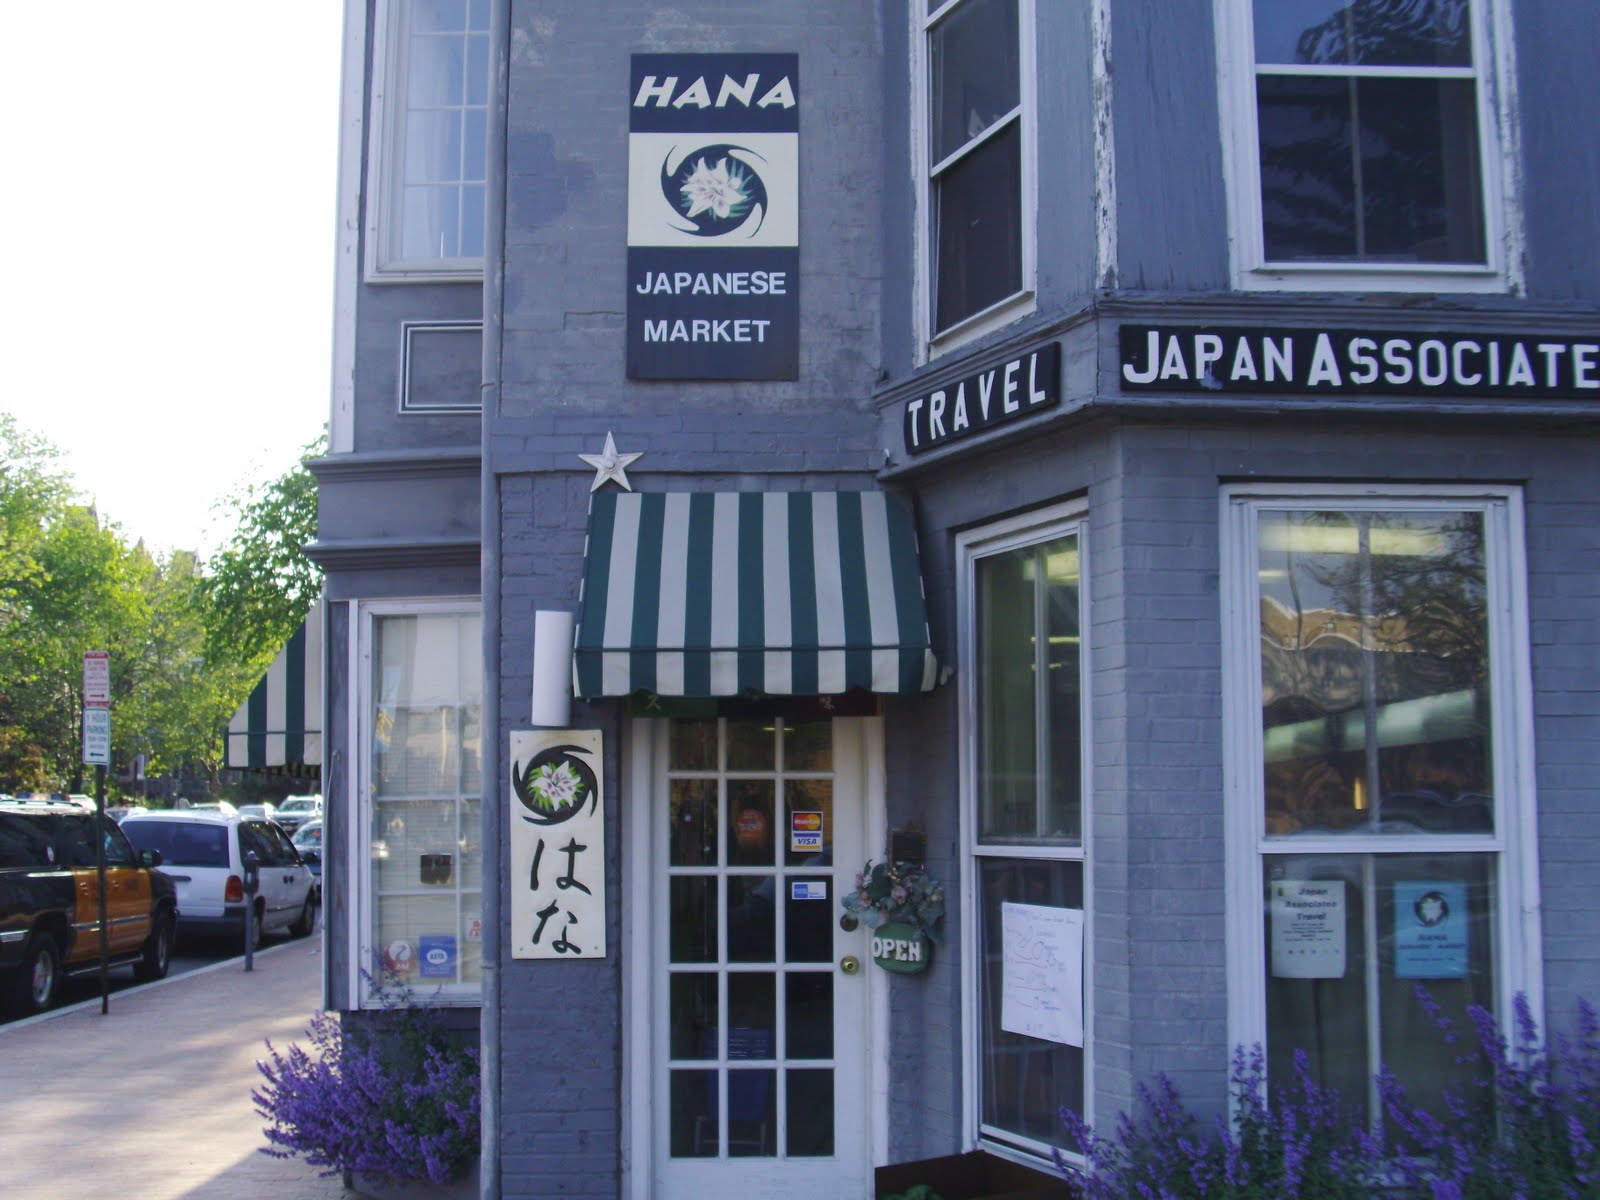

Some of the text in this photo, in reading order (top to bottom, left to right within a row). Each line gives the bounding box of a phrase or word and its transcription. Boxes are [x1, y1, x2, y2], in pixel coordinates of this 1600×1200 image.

[633, 73, 796, 109] HANA
[636, 270, 786, 295] JAPANESE
[643, 319, 771, 342] MARKET
[1122, 330, 1600, 389] JAPAN ASSOCIATE
[907, 352, 1046, 447] TRAVEL
[530, 837, 592, 955] はな
[1298, 888, 1328, 896] Japan
[1296, 912, 1327, 920] Travel
[870, 937, 921, 961] OPEN
